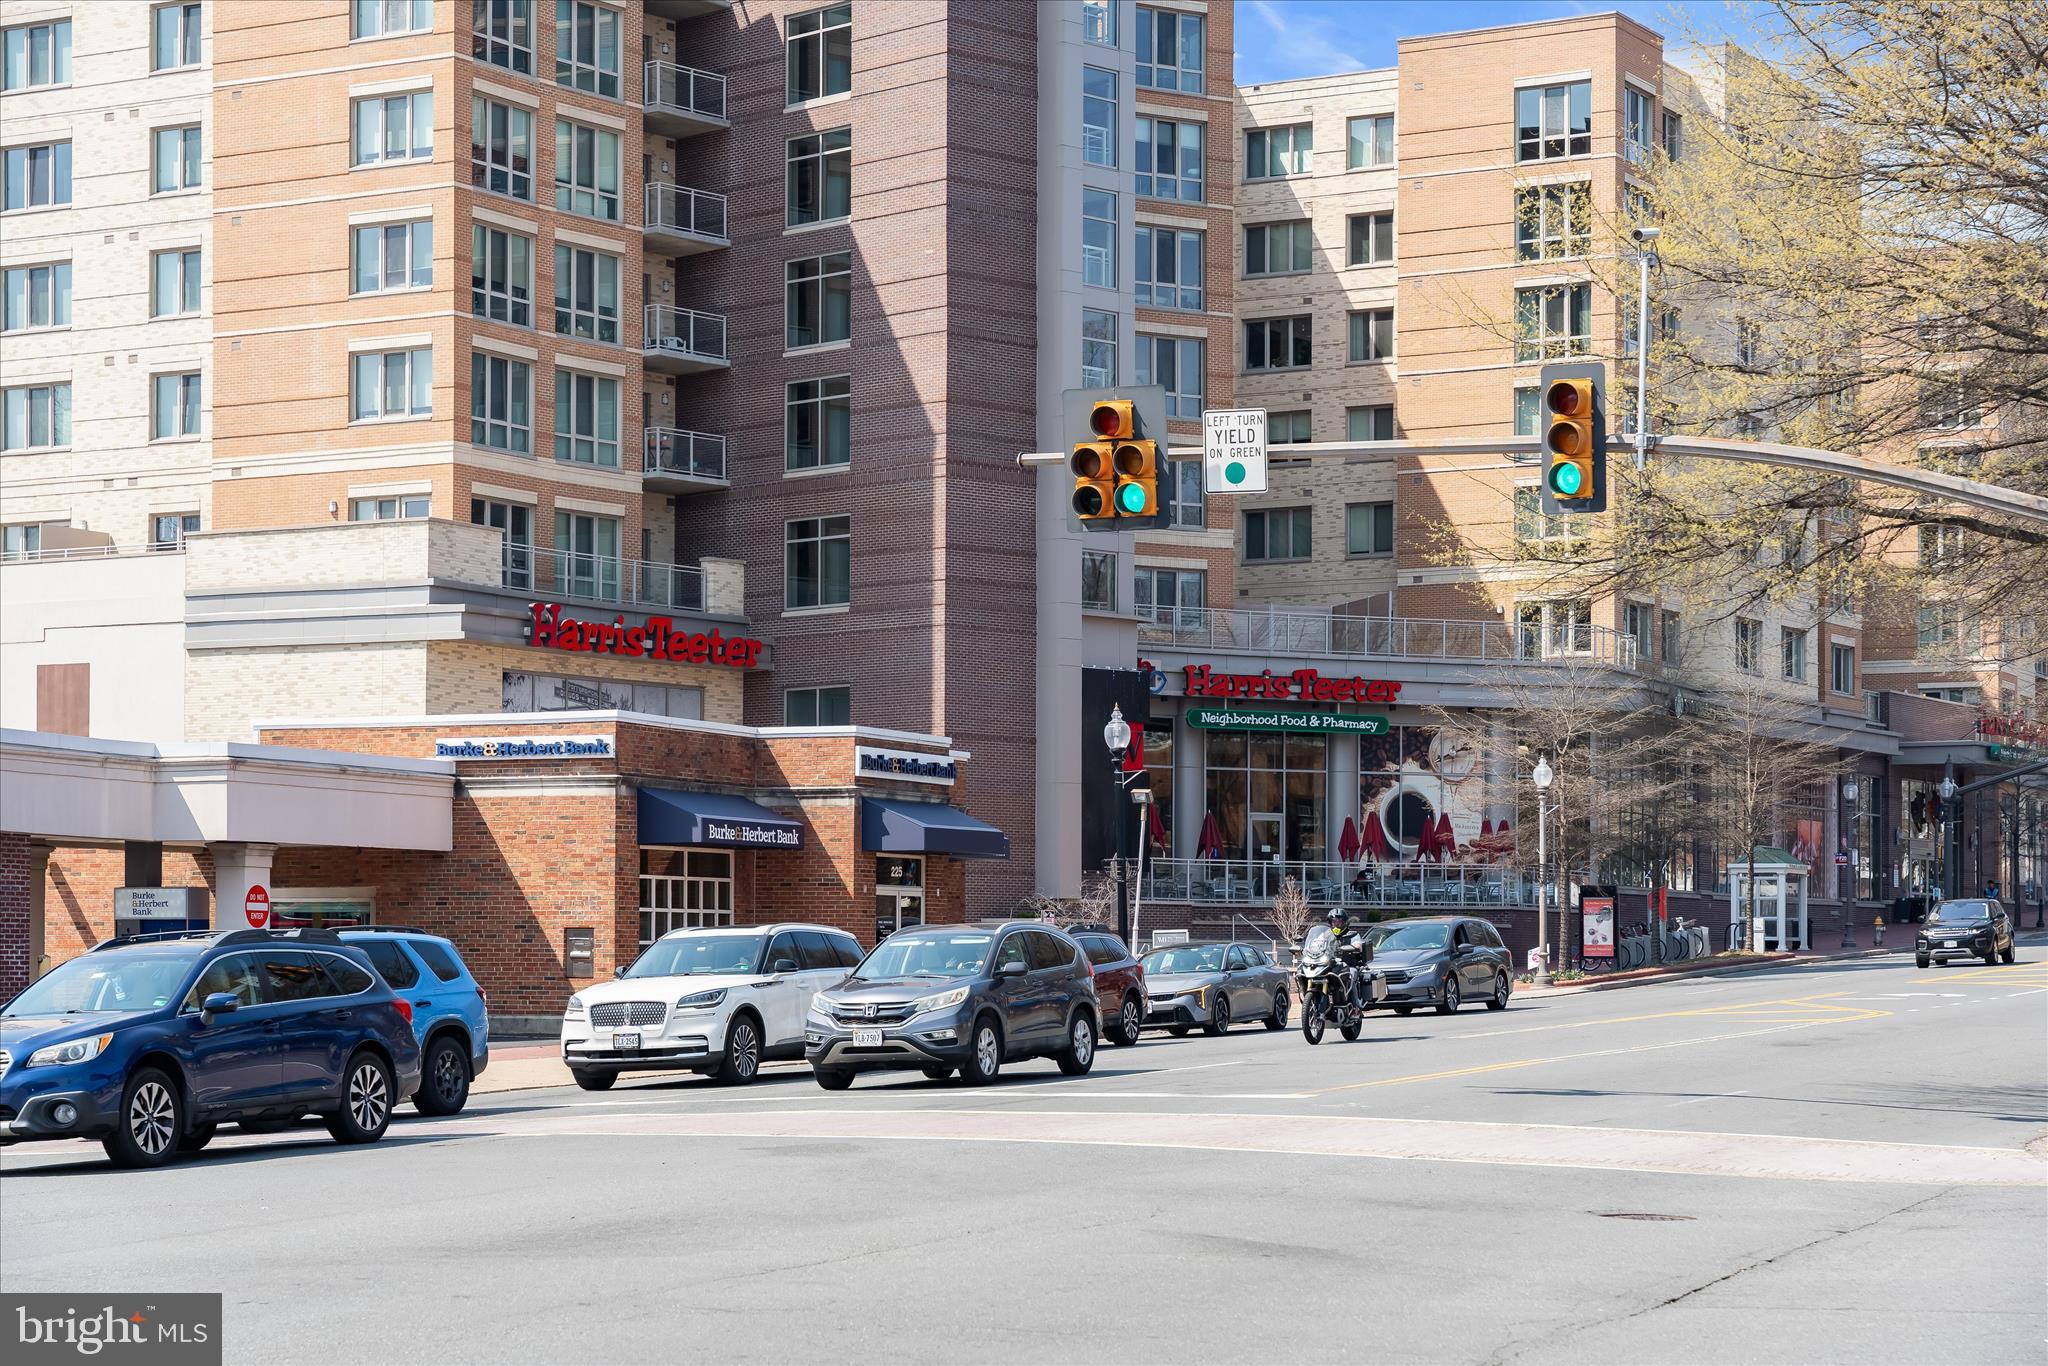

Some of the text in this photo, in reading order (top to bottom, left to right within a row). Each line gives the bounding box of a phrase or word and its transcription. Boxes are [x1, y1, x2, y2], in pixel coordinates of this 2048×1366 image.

[1207, 414, 1263, 427] LEFT TURN
[1214, 428, 1255, 444] YIELD
[1209, 447, 1261, 459] ON GREEN
[528, 602, 762, 668] Harris Teeter
[1184, 663, 1291, 698] Harris
[1292, 668, 1401, 703] Teeter
[1201, 712, 1378, 732] Neighborhood Food & Pharmacy
[563, 738, 611, 755] Bank
[935, 762, 957, 779] Bank
[776, 828, 799, 845] Bank
[890, 865, 903, 878] 225
[132, 891, 156, 900] Burke
[250, 893, 265, 901] DO NOT
[132, 900, 169, 908] &Herbert
[132, 908, 152, 916] Bank
